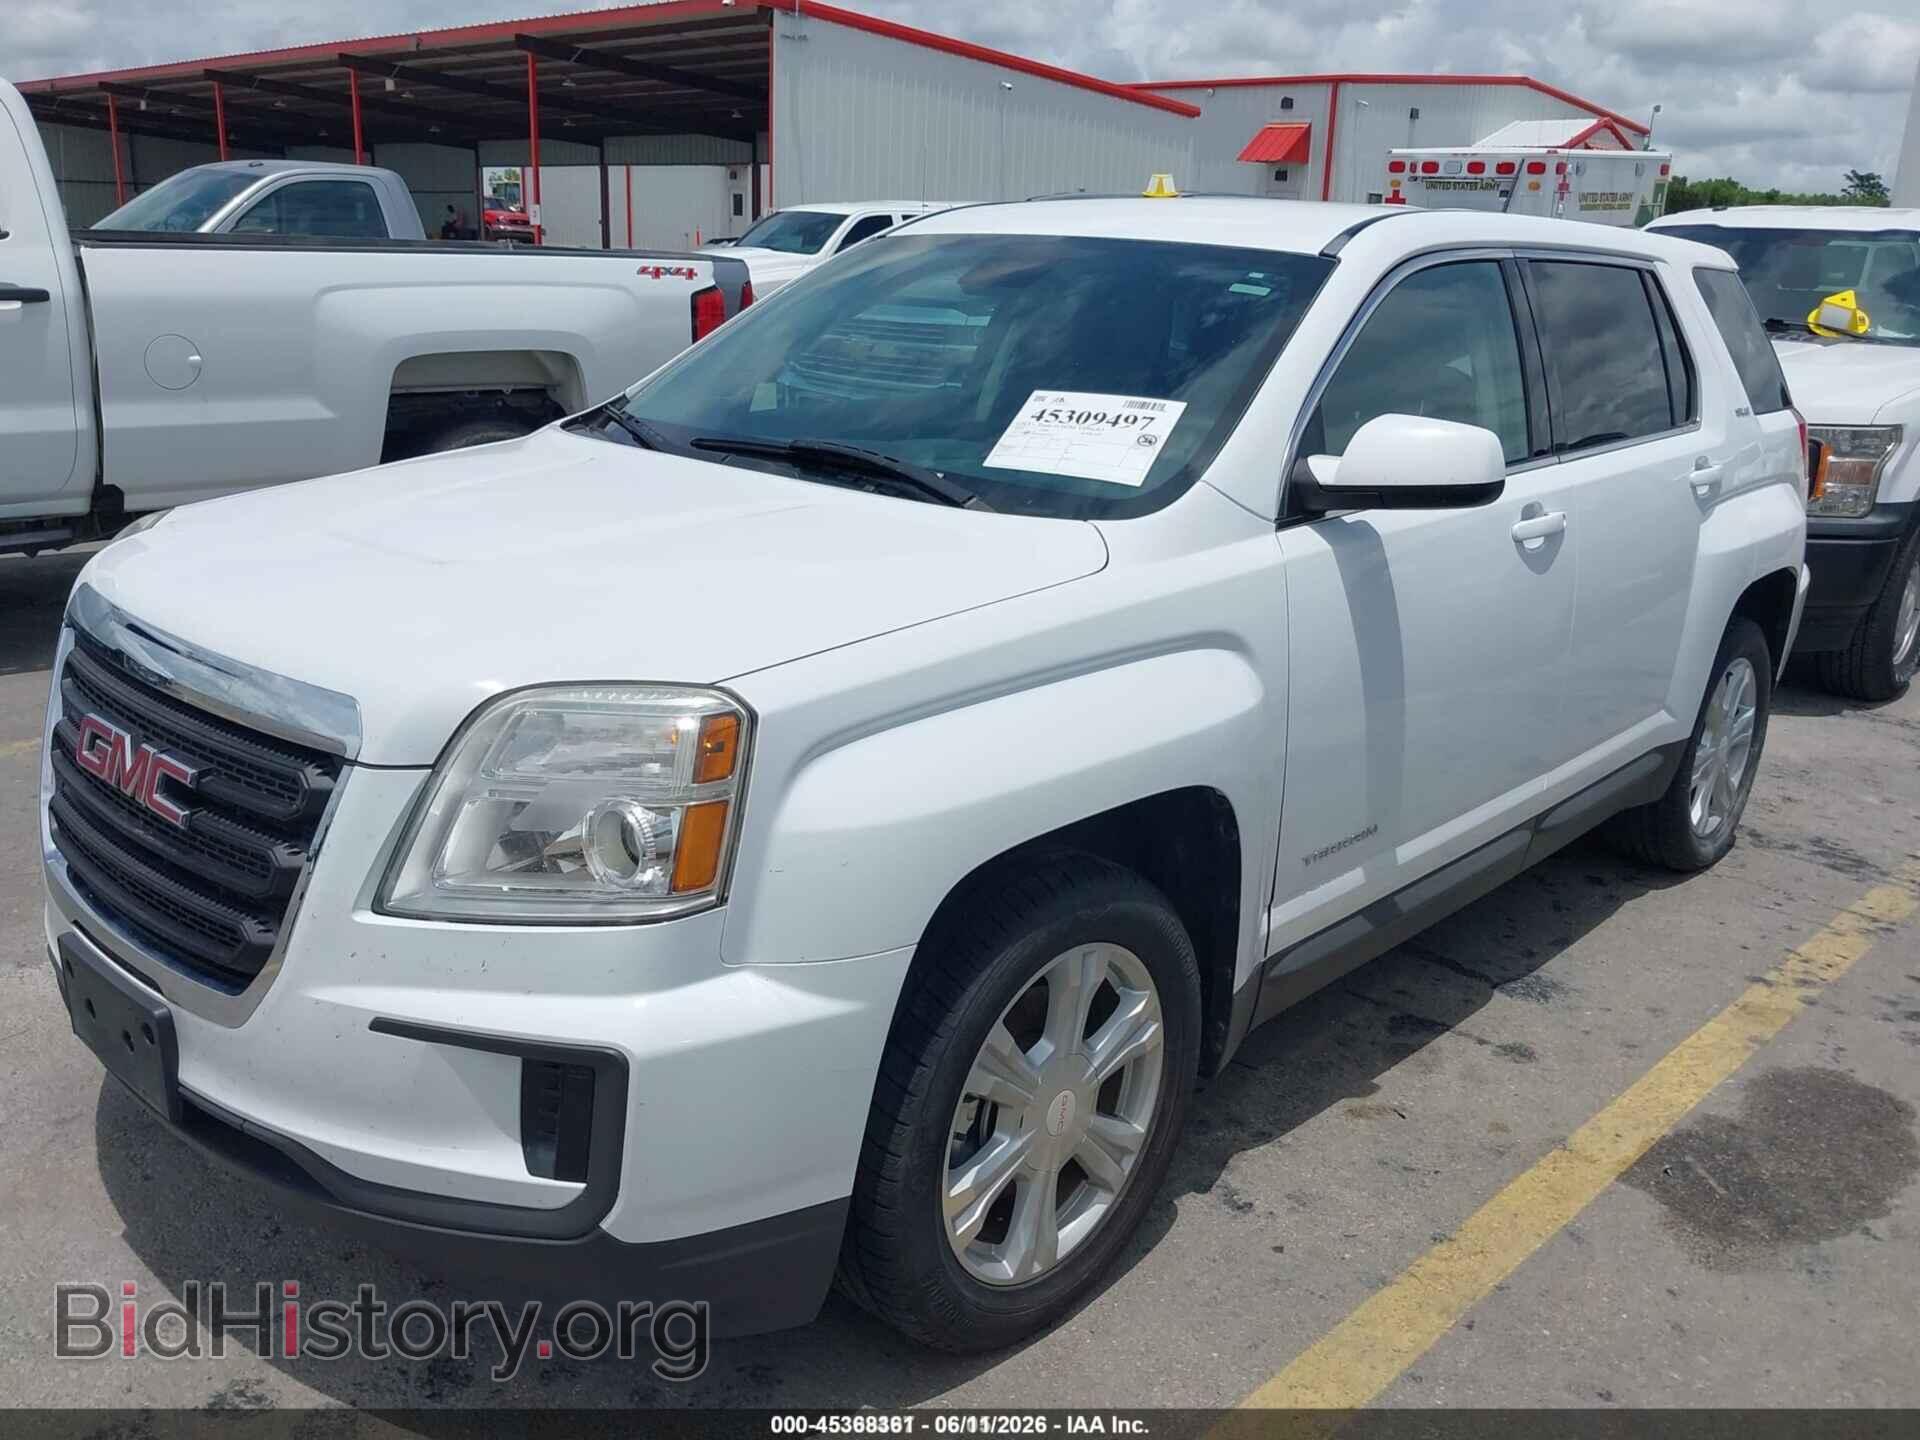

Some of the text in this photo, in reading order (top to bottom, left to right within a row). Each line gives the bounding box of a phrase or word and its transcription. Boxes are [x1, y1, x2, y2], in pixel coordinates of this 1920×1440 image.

[1425, 180, 1500, 192] UNITED STATES ARMY
[1031, 407, 1156, 431] 45309497
[76, 713, 199, 830] GMC
